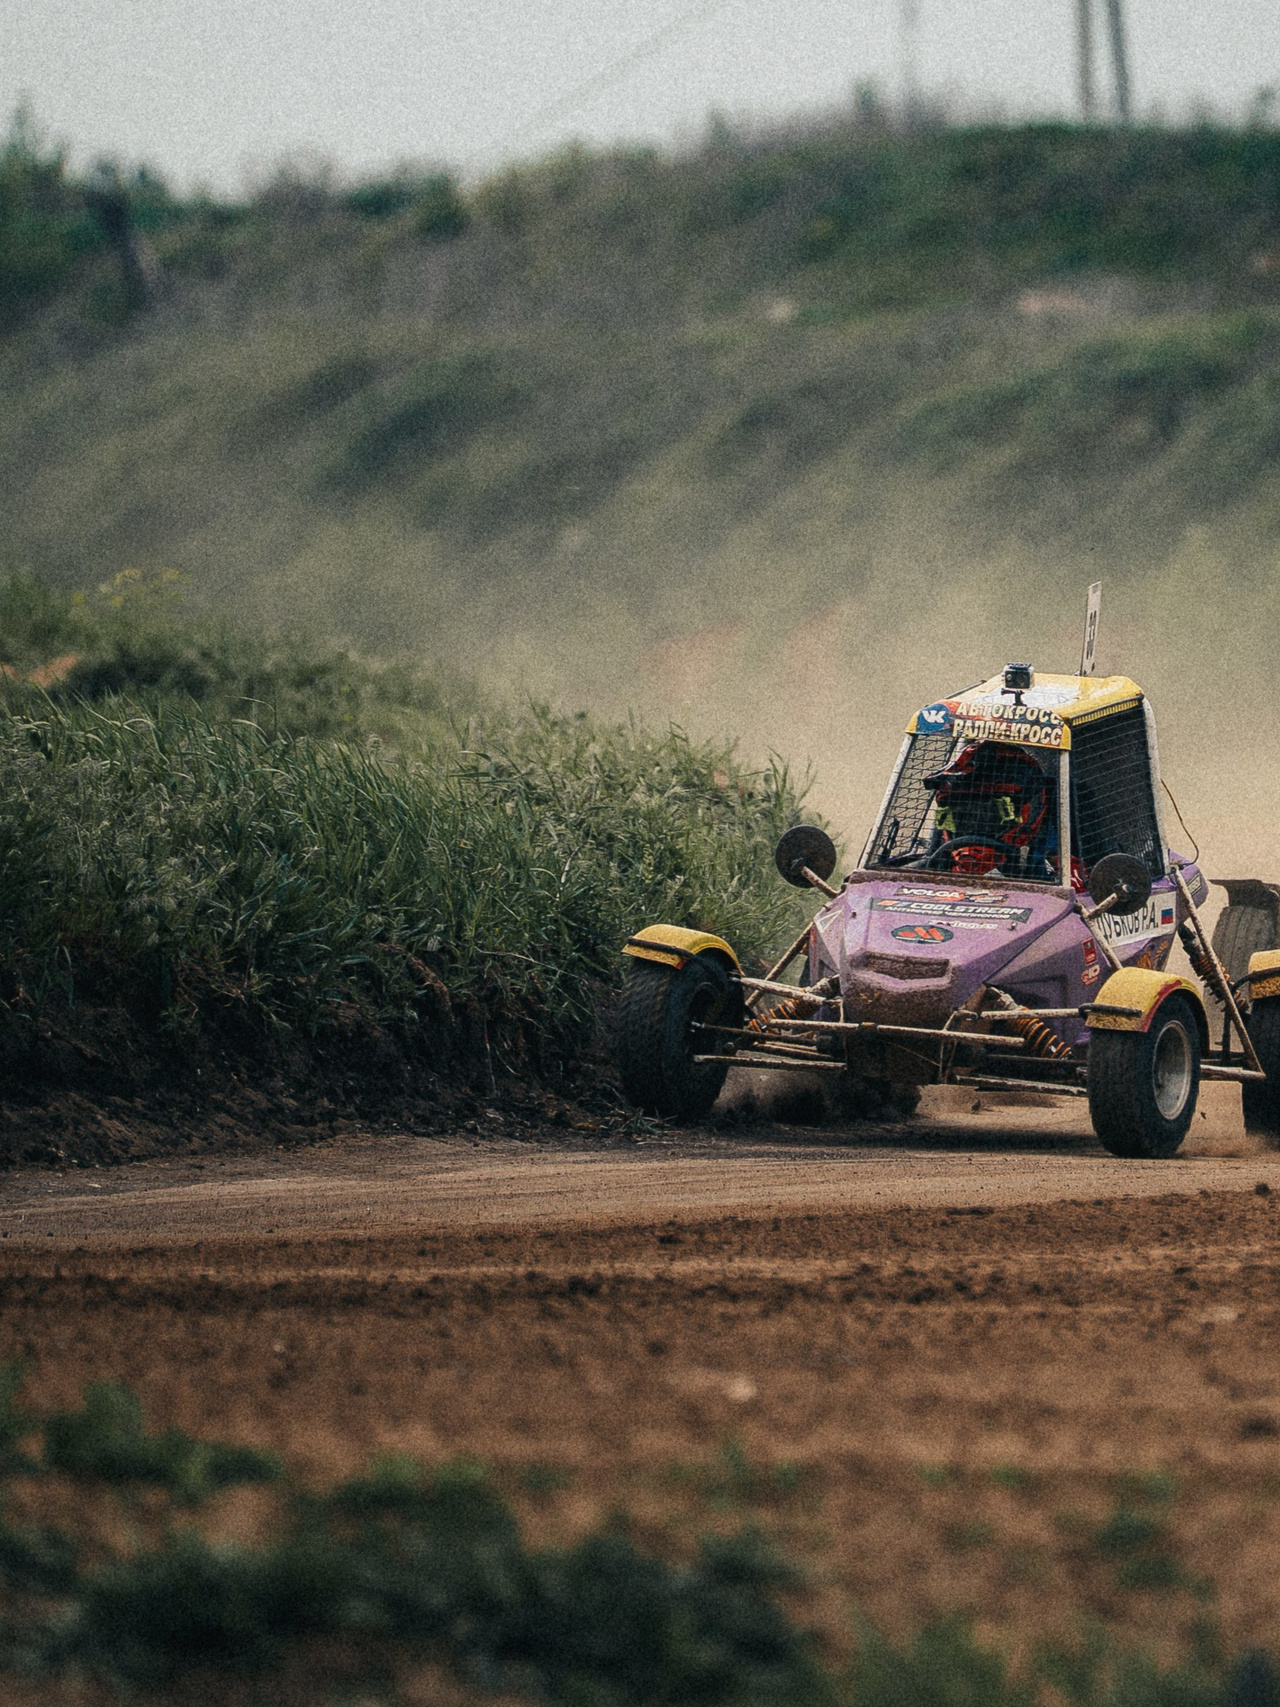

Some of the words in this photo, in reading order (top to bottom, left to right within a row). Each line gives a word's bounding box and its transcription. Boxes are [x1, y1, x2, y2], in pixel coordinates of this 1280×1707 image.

[952, 718, 1063, 746] РАЛЛИ-КРОСС
[902, 888, 961, 899] VOLGA
[909, 902, 1025, 915] COOLSTREAM
